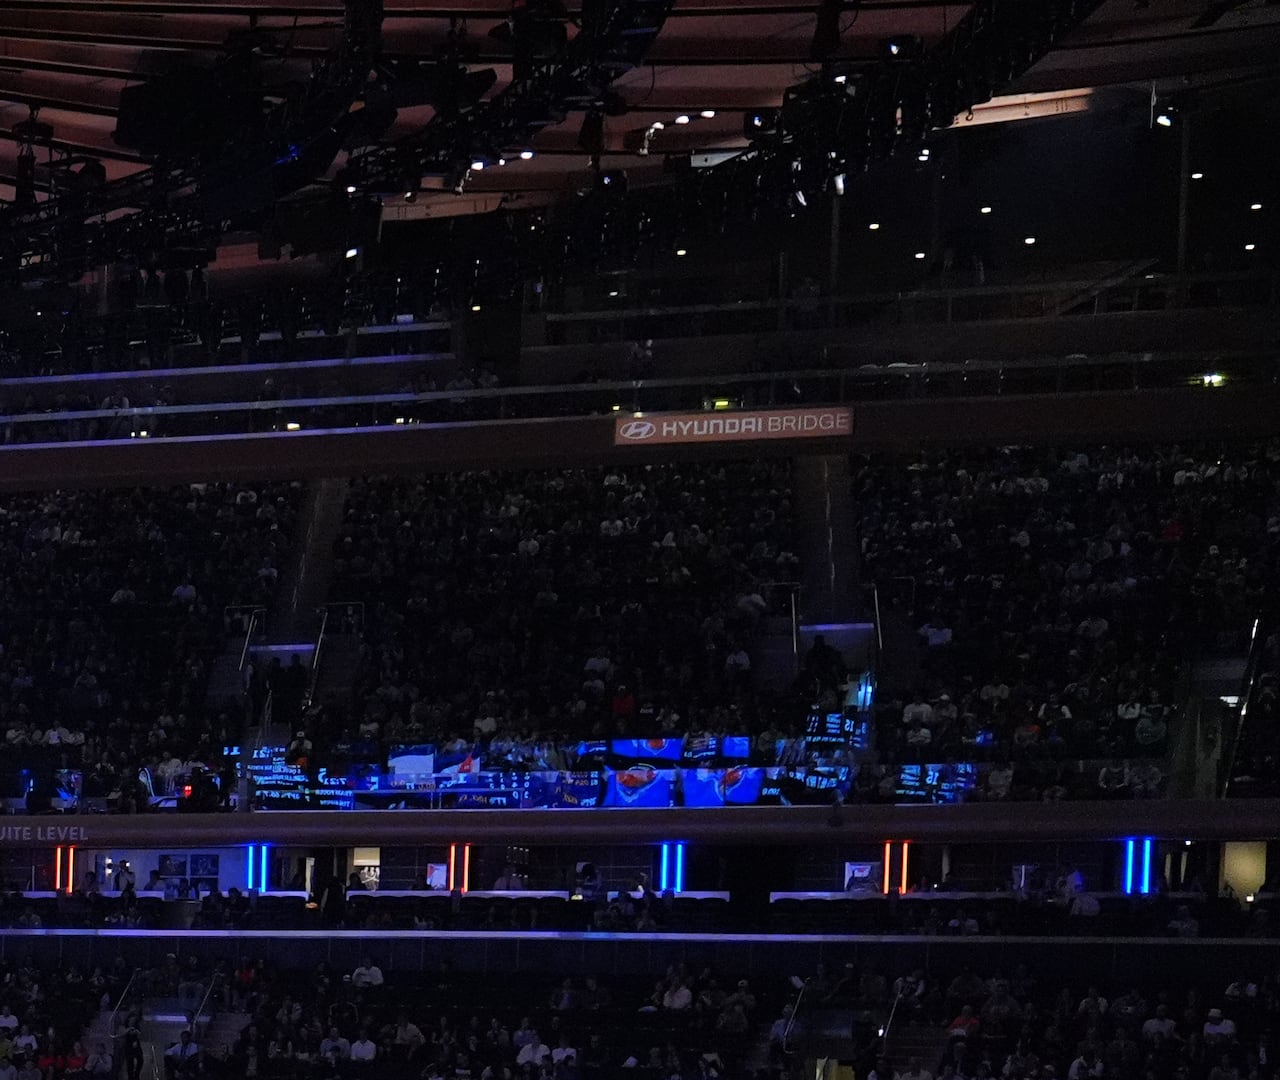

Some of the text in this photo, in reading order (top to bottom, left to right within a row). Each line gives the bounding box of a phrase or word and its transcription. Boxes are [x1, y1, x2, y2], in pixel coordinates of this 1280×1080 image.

[663, 413, 850, 437] HYUNDAI BRIDGE
[37, 826, 89, 842] LEVEL
